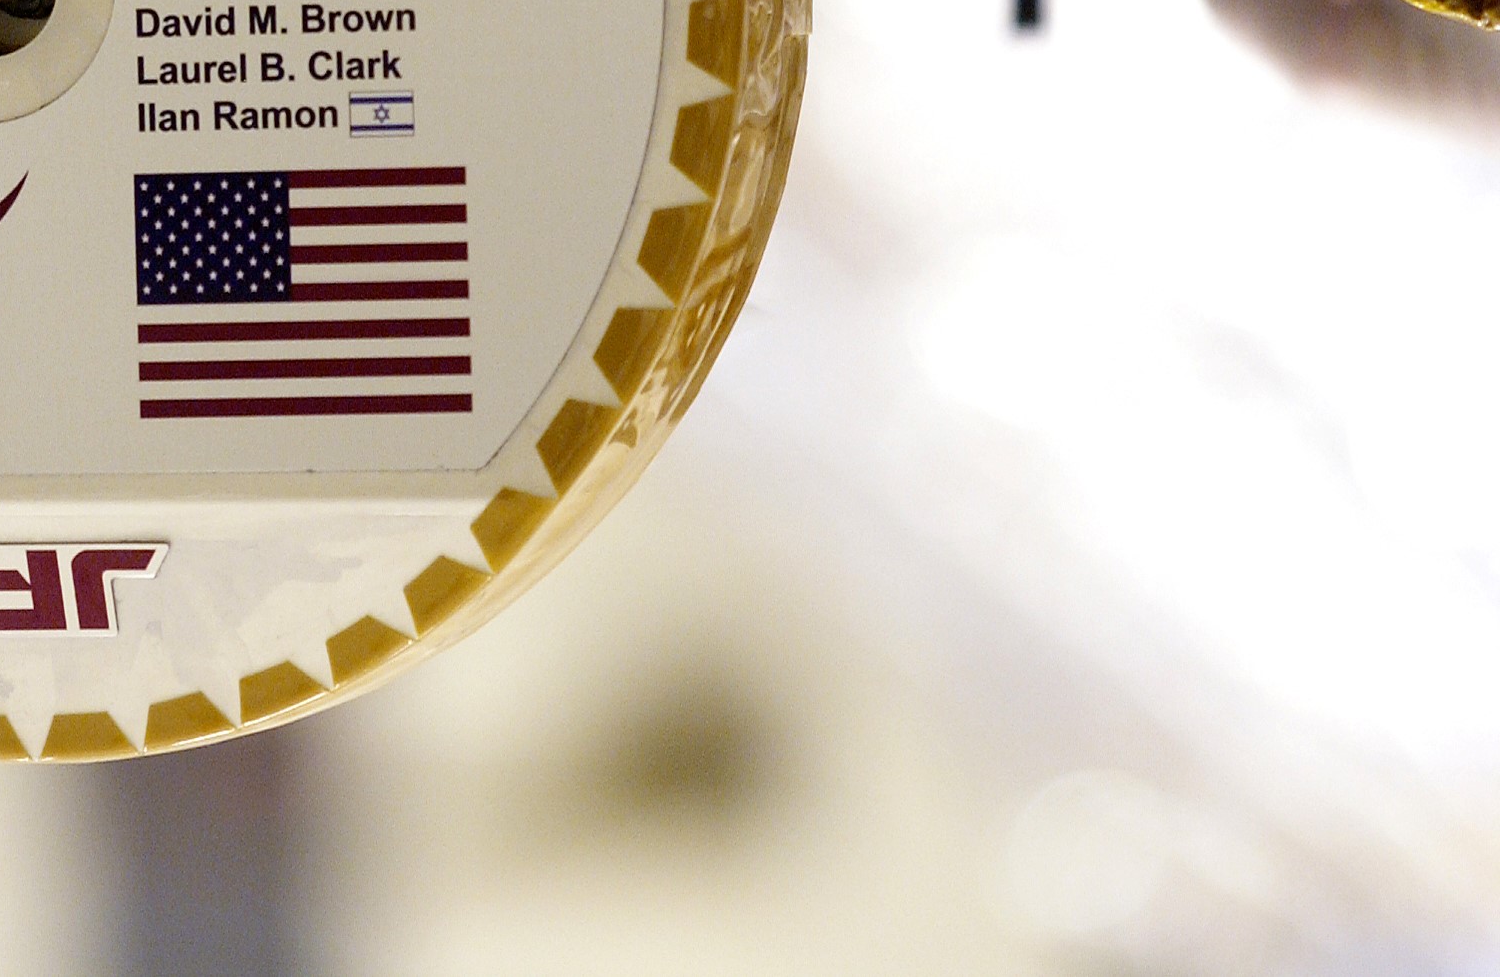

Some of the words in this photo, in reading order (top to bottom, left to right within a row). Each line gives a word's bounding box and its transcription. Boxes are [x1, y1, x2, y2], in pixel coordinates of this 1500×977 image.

[135, 6, 235, 38] David
[249, 5, 288, 35] M.
[301, 4, 416, 33] Brown
[137, 53, 247, 85] Laurel
[260, 52, 295, 82] B.
[308, 49, 402, 81] Clark
[138, 102, 200, 132] Ilan
[213, 101, 338, 131] Ramon
